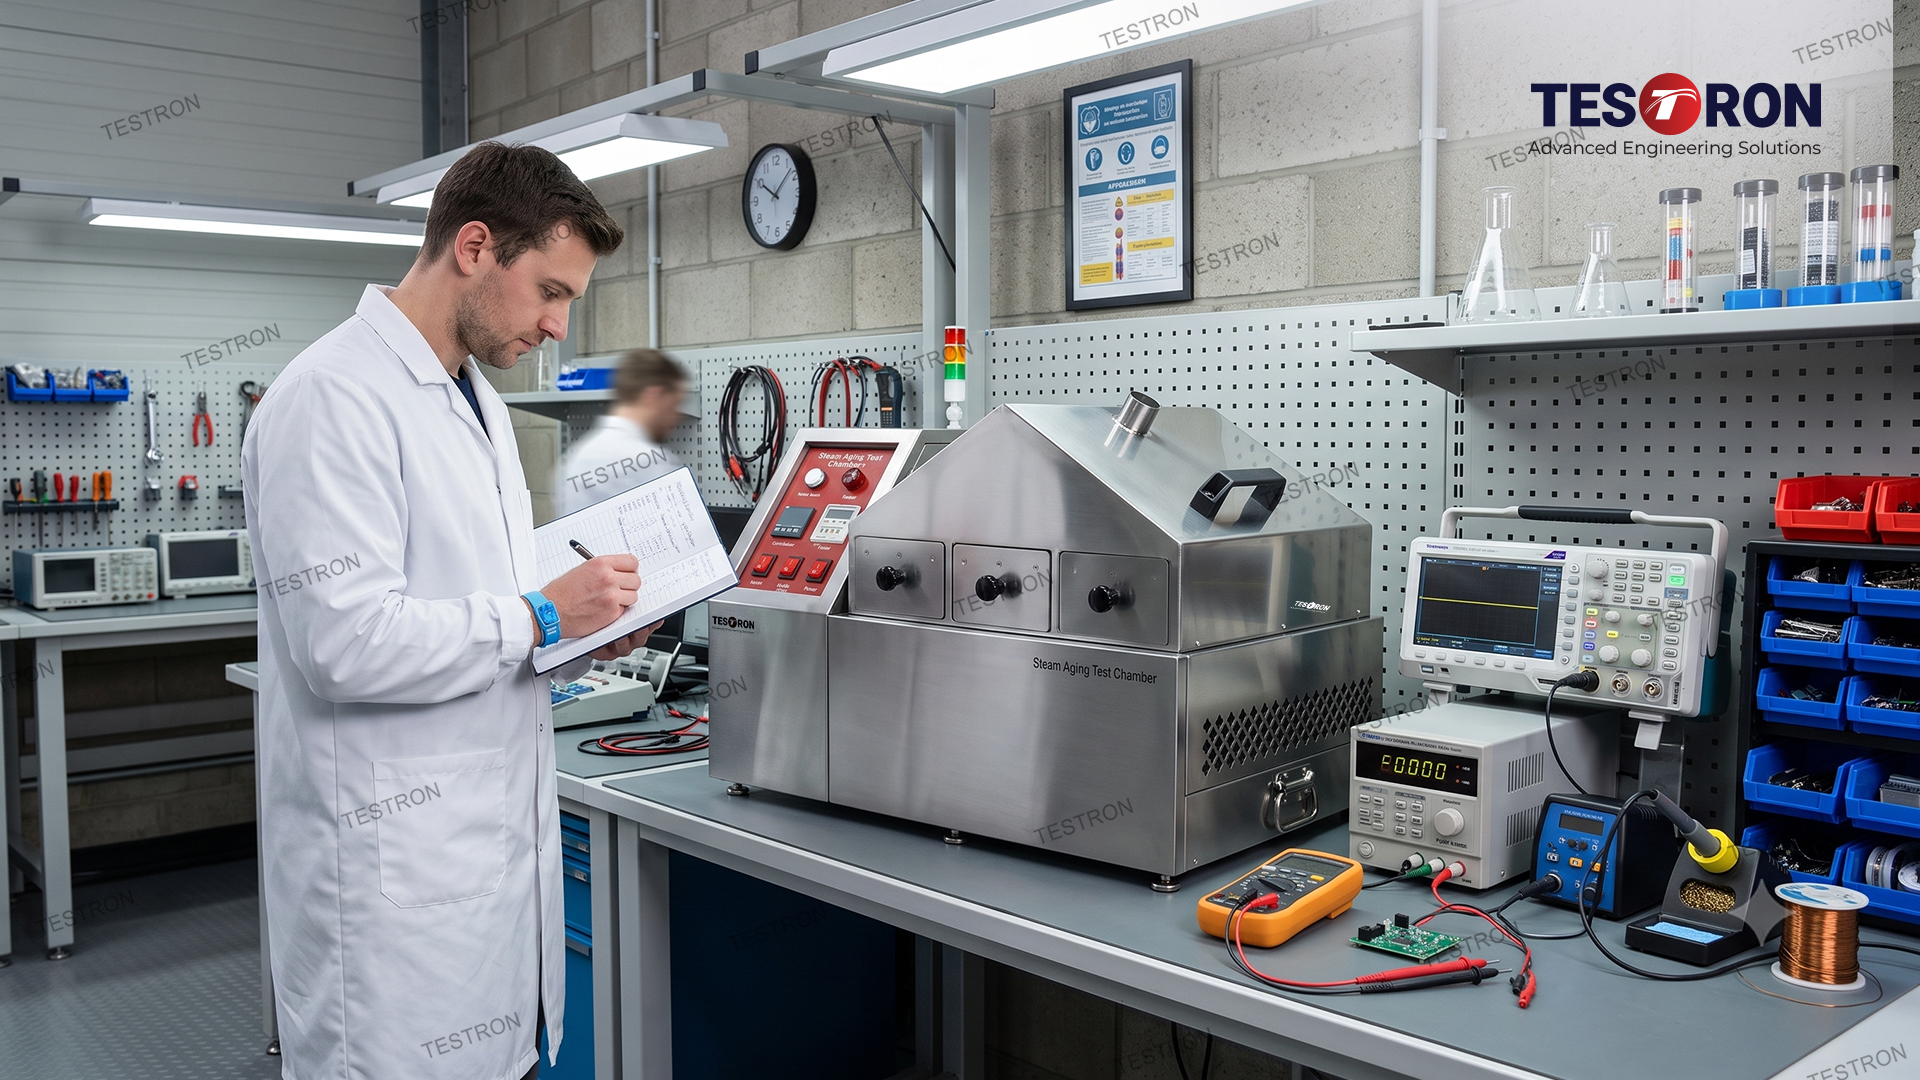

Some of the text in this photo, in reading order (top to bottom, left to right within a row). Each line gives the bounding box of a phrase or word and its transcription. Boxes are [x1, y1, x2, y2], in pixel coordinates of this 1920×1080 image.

[772, 154, 780, 166] 12
[763, 162, 769, 175] 11
[791, 170, 798, 181] 2
[754, 177, 764, 189] 10
[753, 195, 759, 207] 9
[757, 213, 763, 224] 8
[765, 225, 771, 236] 7
[785, 220, 791, 231] 5
[774, 226, 780, 237] 6
[1033, 657, 1158, 684] Steam Aging Test Chamber
